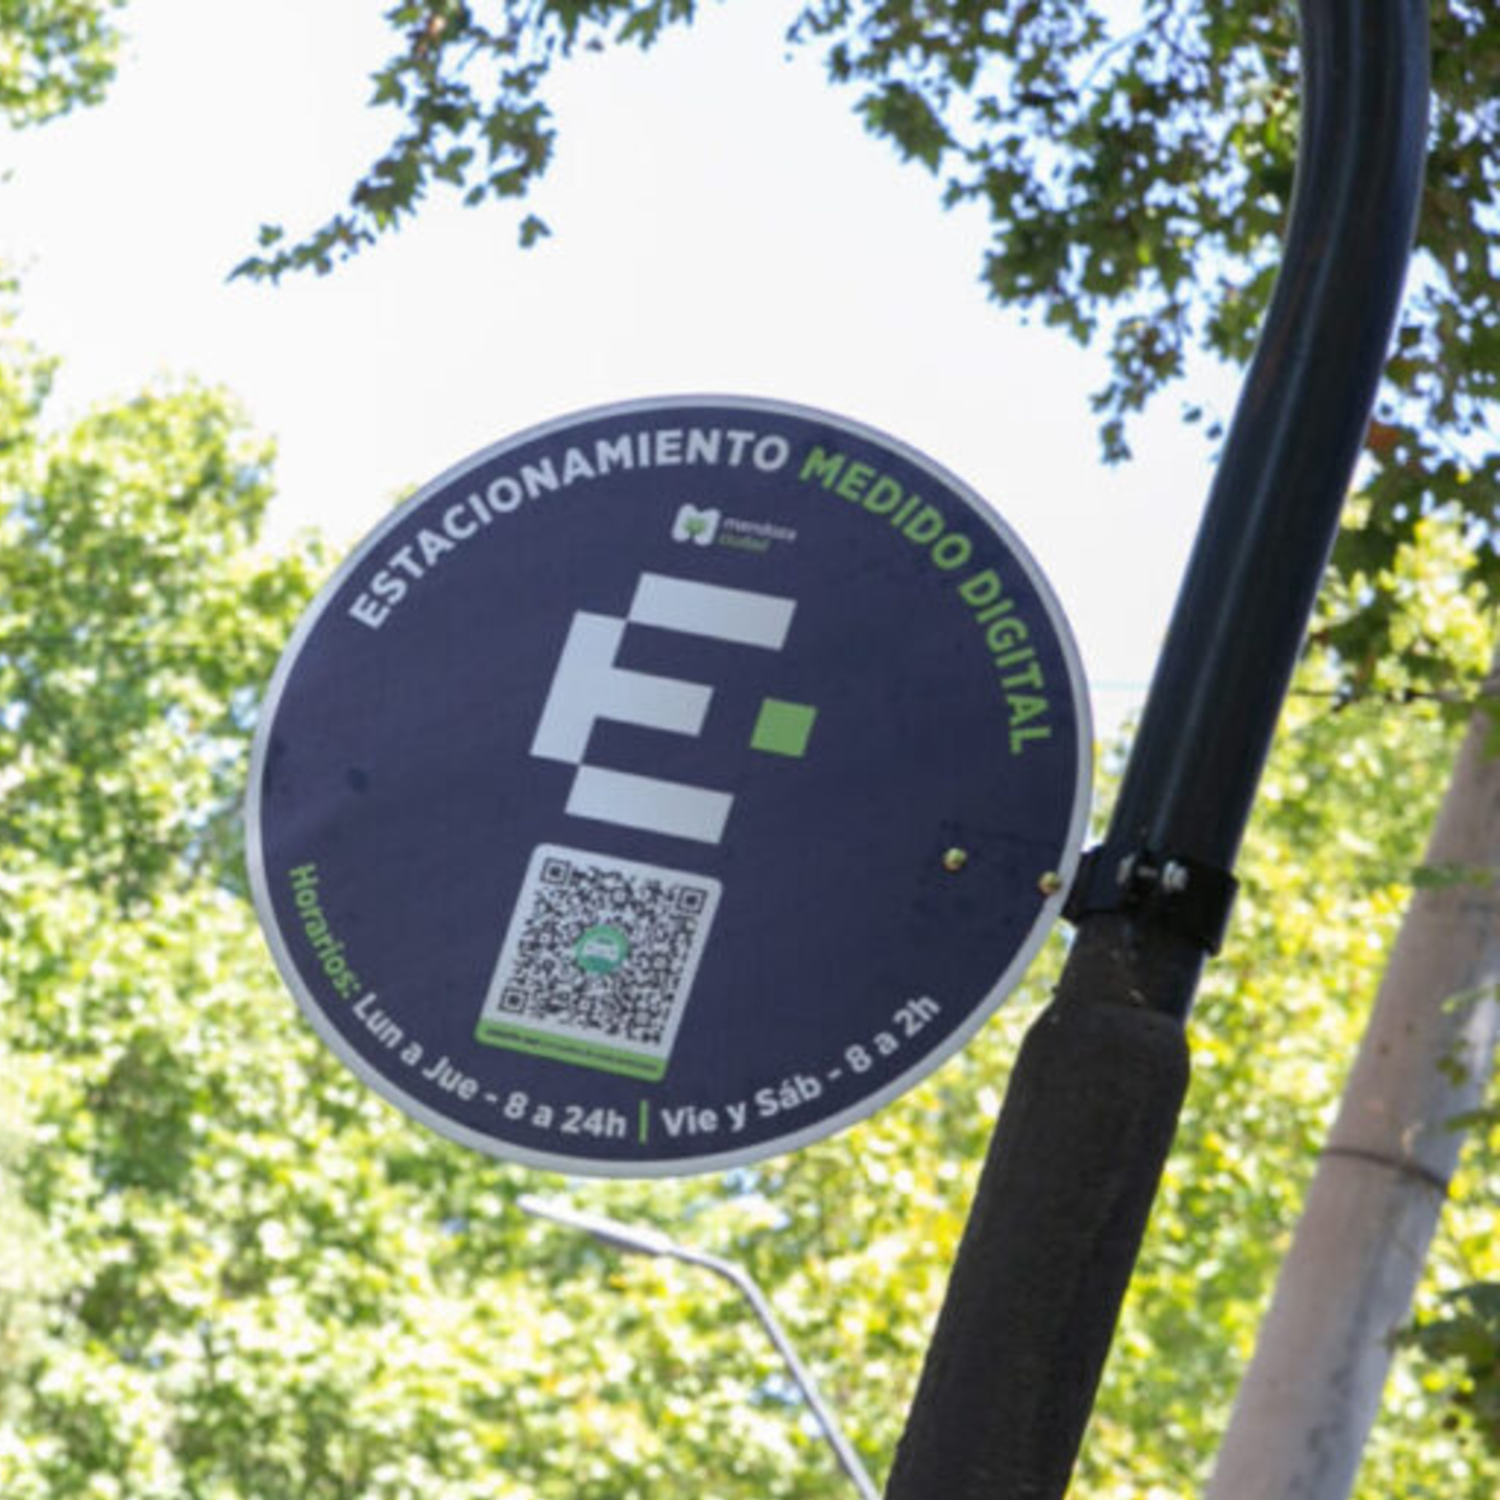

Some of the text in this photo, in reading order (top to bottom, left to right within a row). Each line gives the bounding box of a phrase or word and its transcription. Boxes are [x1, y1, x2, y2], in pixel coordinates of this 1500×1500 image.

[348, 429, 1051, 755] ESTACIONAMIENTO MEDIDO DIGITAL
[289, 862, 362, 999] Horarios:
[352, 992, 405, 1049] Lun
[400, 1042, 424, 1066] a
[422, 1055, 479, 1100] Jue
[503, 1091, 529, 1119] 8
[531, 1105, 553, 1128] a
[560, 1105, 627, 1138] 24h
[661, 1105, 718, 1136] Vie
[726, 1102, 747, 1132] y
[754, 1074, 822, 1117] Sáb
[844, 1044, 872, 1073] 8
[873, 1031, 899, 1056] a
[892, 996, 941, 1038] 2h
